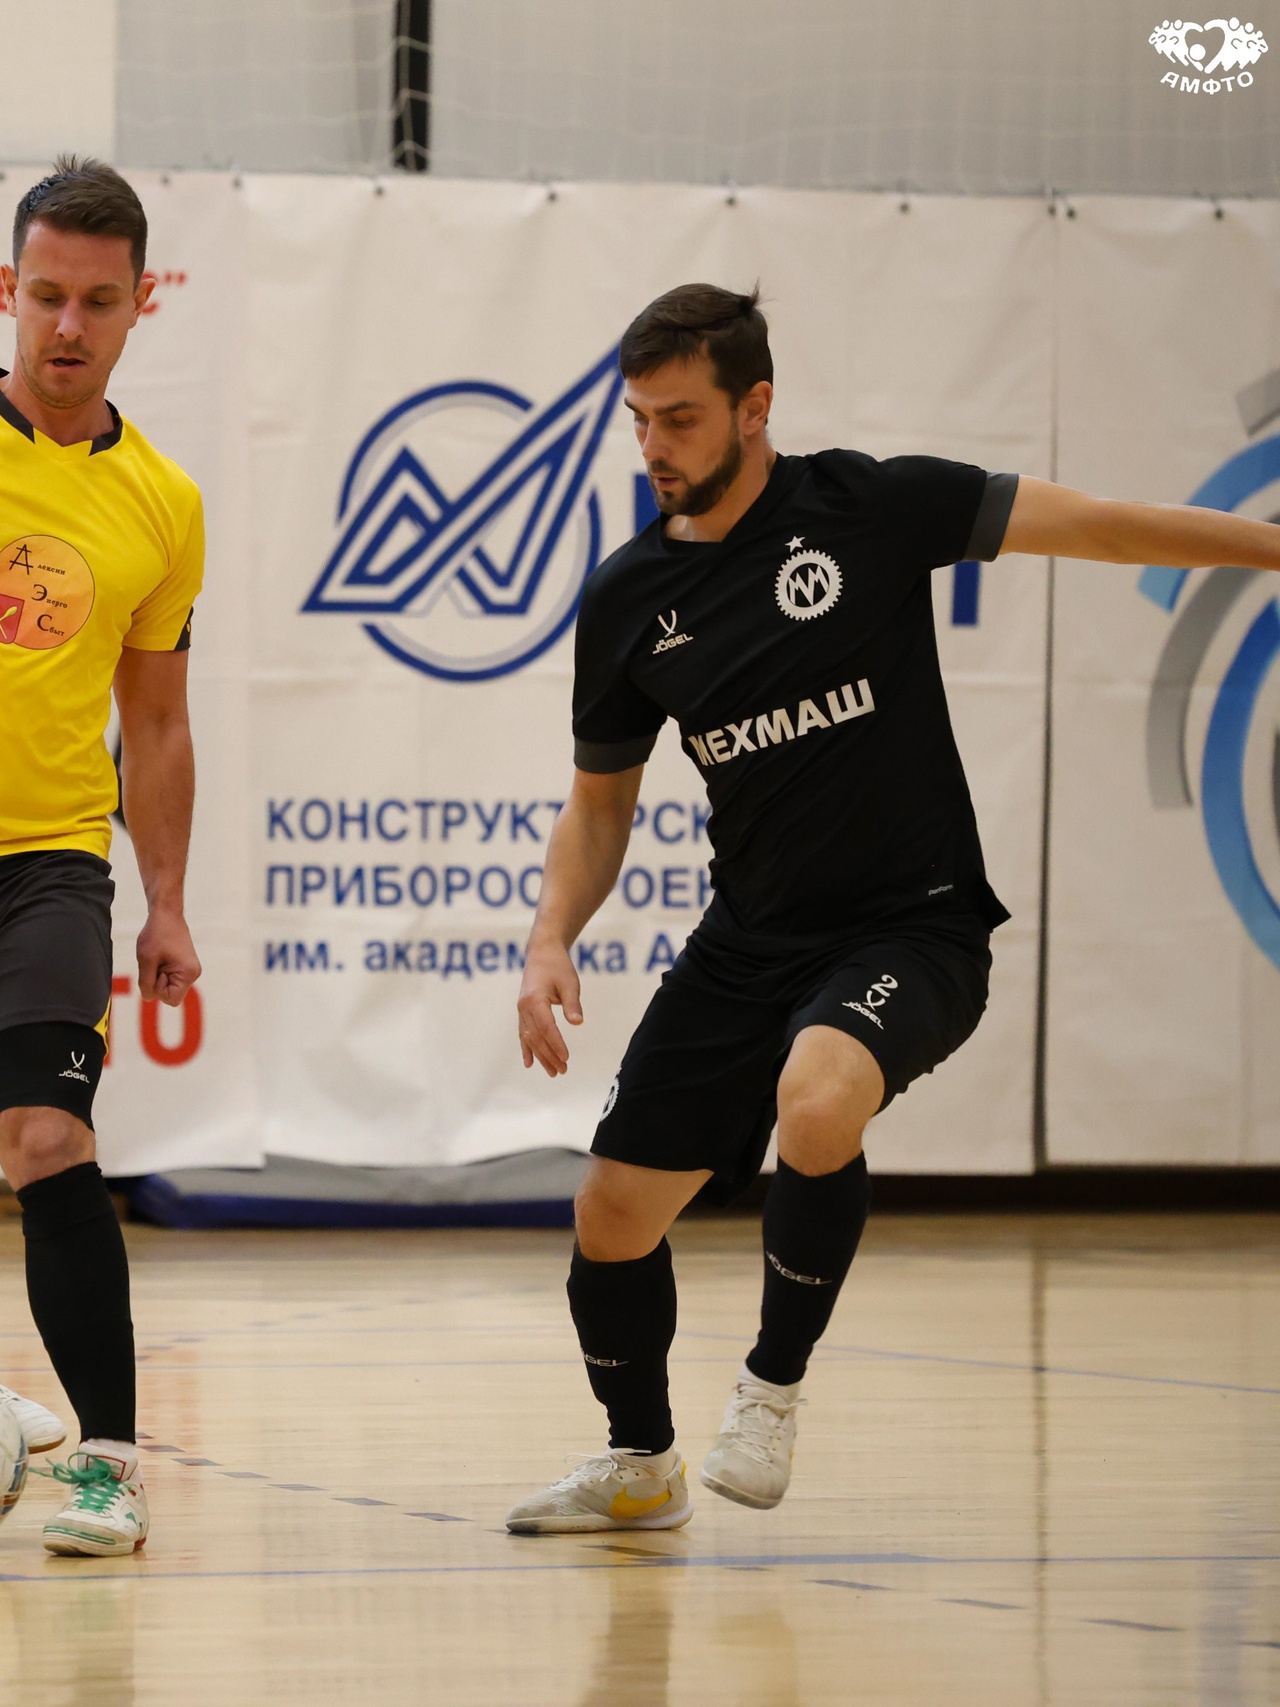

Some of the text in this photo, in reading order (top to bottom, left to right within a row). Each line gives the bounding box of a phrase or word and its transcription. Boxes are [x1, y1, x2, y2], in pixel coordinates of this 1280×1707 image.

[652, 633, 694, 655] JÖGEL
[264, 941, 344, 973] им.
[871, 974, 898, 997] 2
[841, 1001, 885, 1030] JÖGEL
[59, 1069, 90, 1083] JÖGEL
[765, 1250, 833, 1285] JÖGEL
[581, 1348, 629, 1367] GEL
